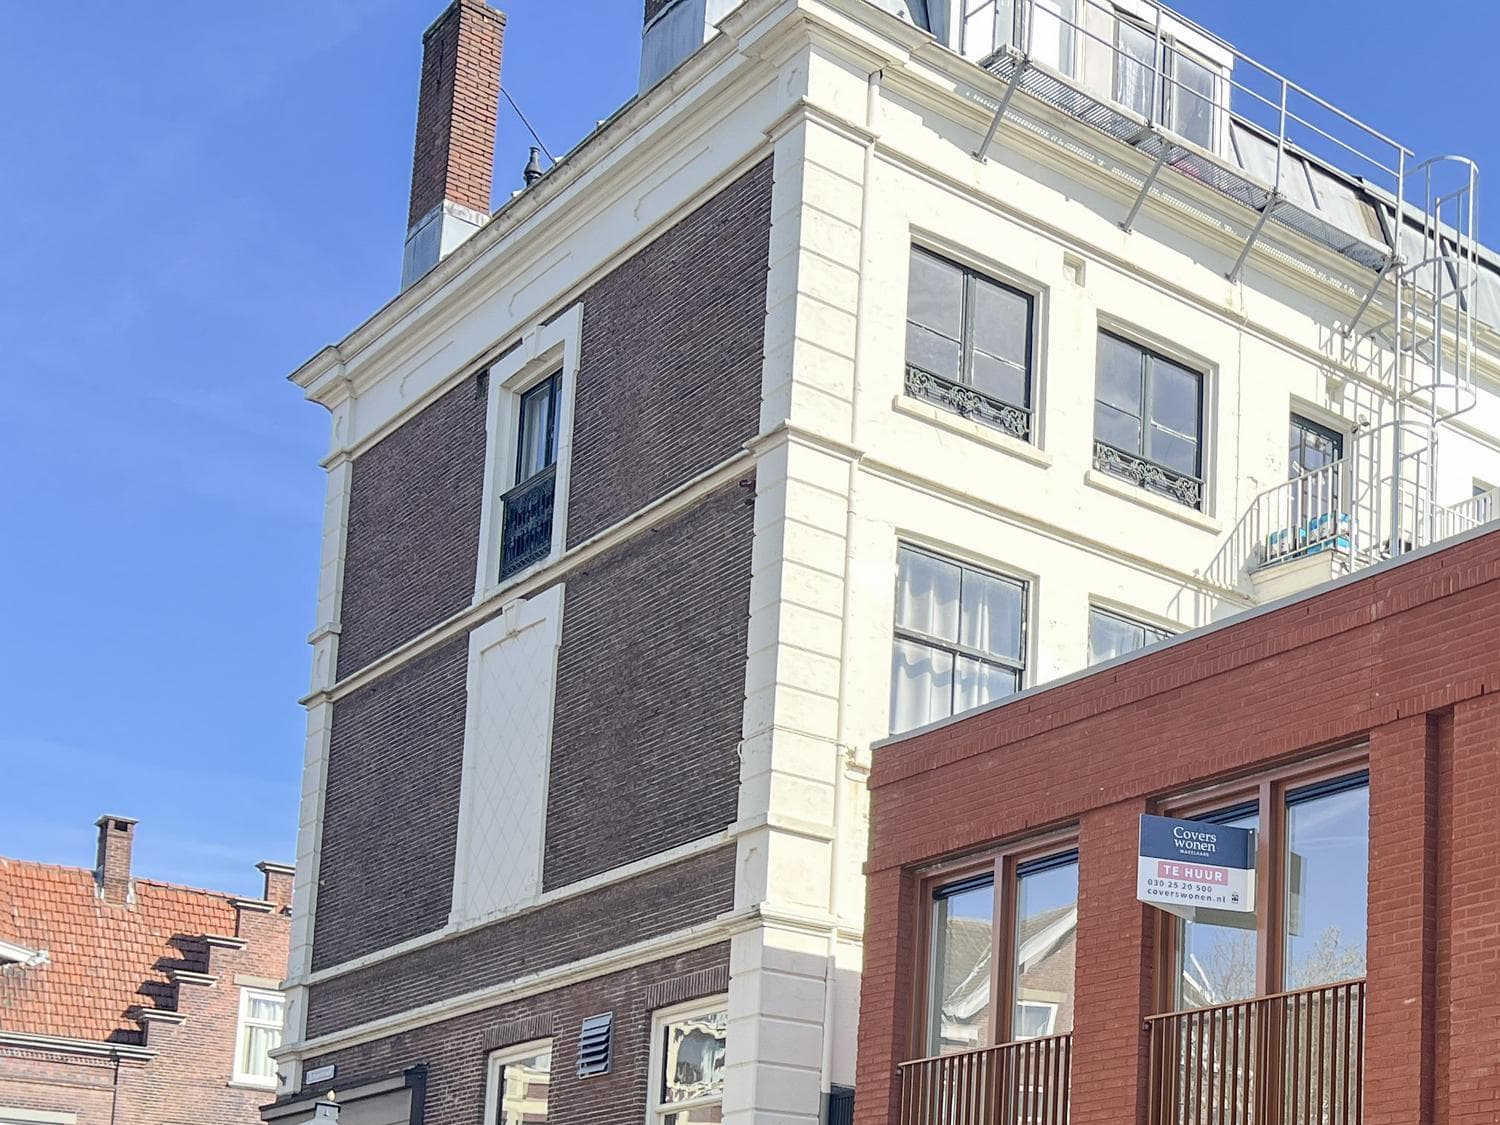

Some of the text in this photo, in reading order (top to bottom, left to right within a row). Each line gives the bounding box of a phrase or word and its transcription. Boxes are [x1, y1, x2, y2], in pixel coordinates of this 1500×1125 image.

[1173, 826, 1217, 843] Covers
[1174, 839, 1216, 852] wonen
[1163, 864, 1223, 881] TE HUUR
[1147, 879, 1164, 887] 030
[1168, 881, 1178, 889] 25
[1196, 884, 1213, 892] 500
[1147, 888, 1226, 903] coverswonen.nl
